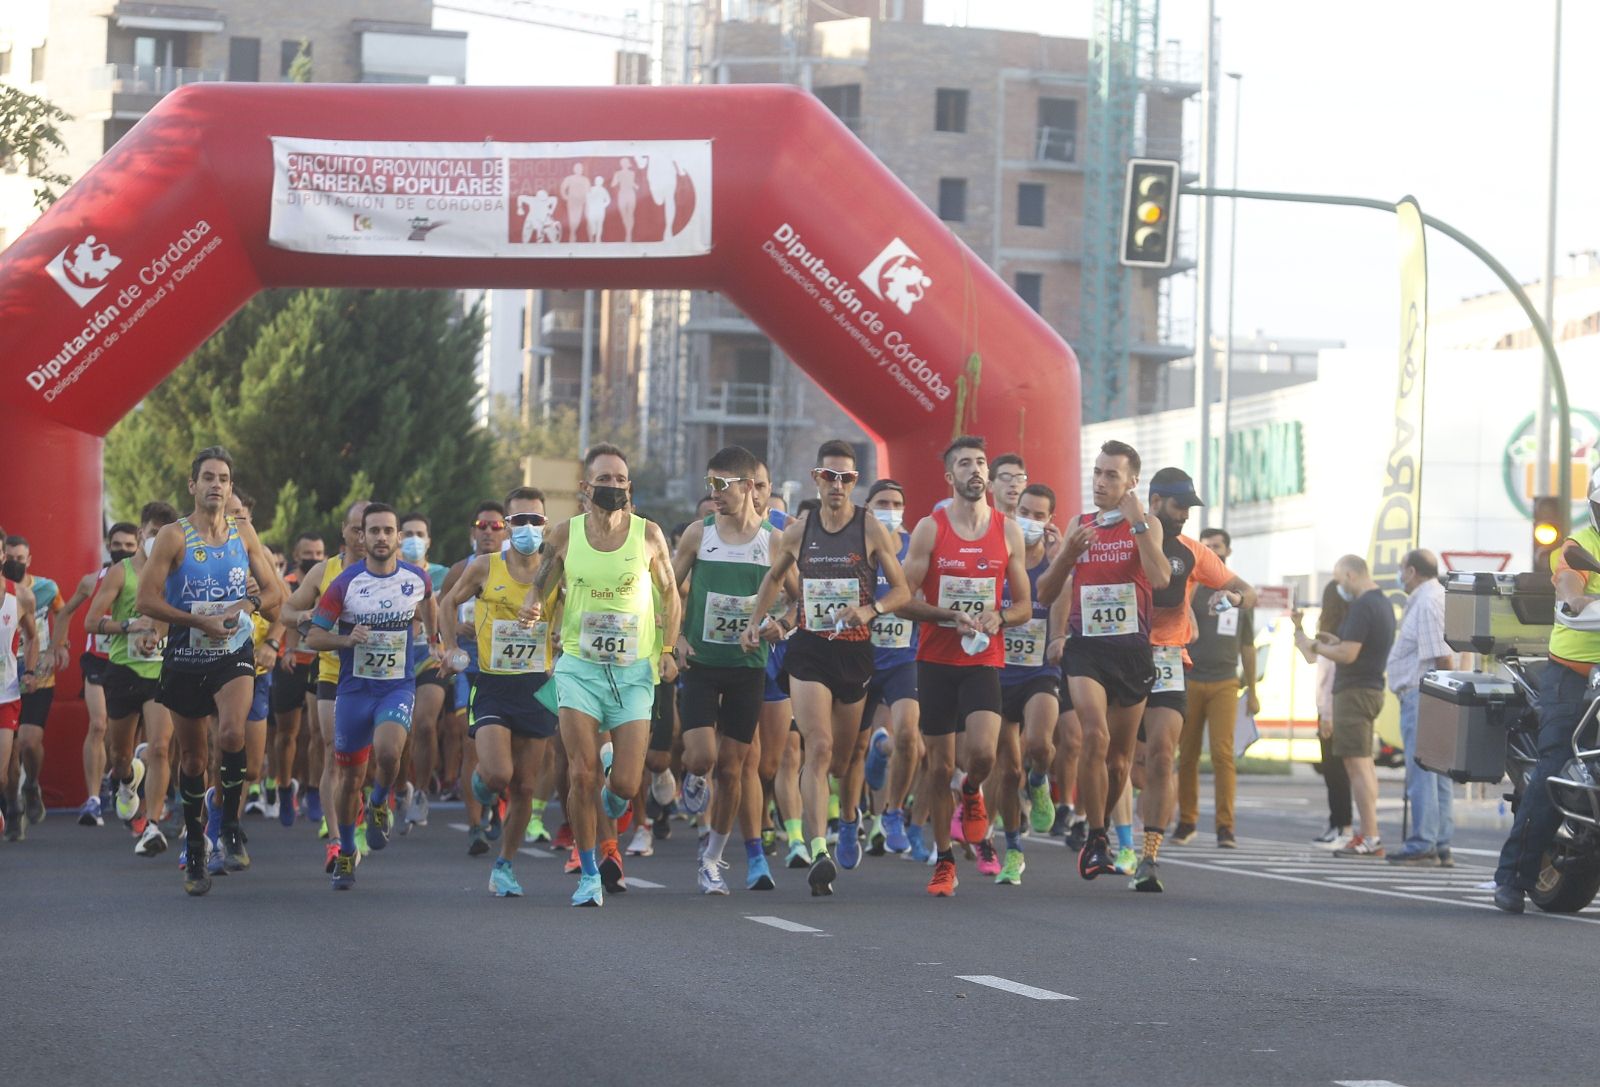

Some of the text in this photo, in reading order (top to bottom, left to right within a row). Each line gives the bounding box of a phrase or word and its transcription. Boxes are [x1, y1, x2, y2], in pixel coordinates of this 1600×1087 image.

[287, 154, 504, 177] CIRCUITO PROVINCIAL DE
[287, 172, 387, 193] CARRERAS
[393, 177, 503, 195] POPULARES
[287, 193, 504, 212] DIPUTACIÓN DE CÓRDOBA
[25, 220, 211, 390] Diputación de Córdoba
[773, 223, 951, 401] Diputación de Córdoba
[43, 236, 223, 402] Delegación de Juventud y Deportes
[762, 240, 936, 412] Delegación de Juventud y Deportes
[1090, 540, 1133, 551] ntorcha
[1090, 550, 1133, 563] ndújar
[950, 600, 984, 616] 479
[1092, 608, 1127, 623] 410
[716, 616, 750, 632] 245
[871, 622, 903, 636] 440
[502, 643, 537, 659] 477
[591, 636, 626, 653] 461
[1005, 638, 1035, 654] 393
[365, 652, 396, 667] 275
[1154, 666, 1173, 680] 03
